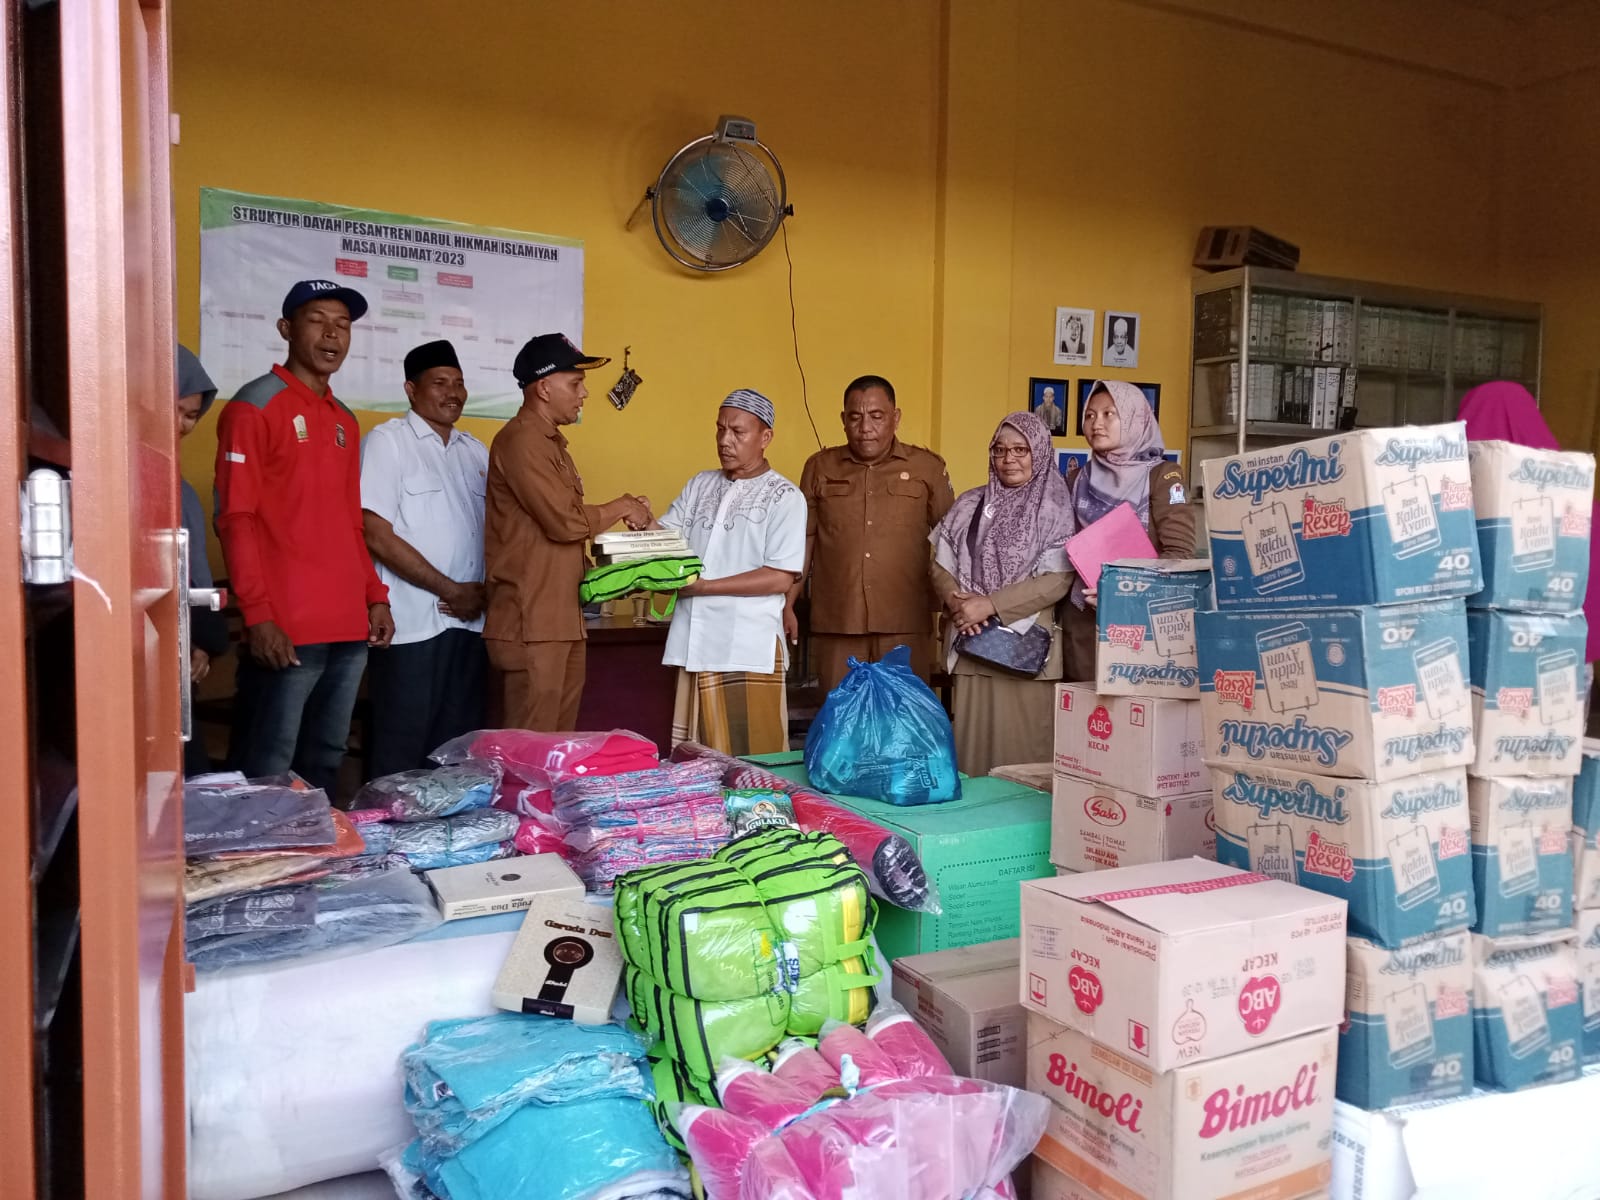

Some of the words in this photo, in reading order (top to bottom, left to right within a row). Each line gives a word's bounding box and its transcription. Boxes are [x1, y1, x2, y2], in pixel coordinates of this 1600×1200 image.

[232, 206, 300, 227] STRUKTUR
[303, 215, 342, 232] DAYAH
[344, 221, 412, 242] PESANTREN
[415, 231, 451, 247] DARUL
[454, 235, 499, 253] HIKMAH
[501, 243, 558, 261] ISLAMIYAH
[342, 238, 377, 254] MASA
[380, 242, 432, 262] KHIDMAT
[435, 251, 465, 266] 2023
[1247, 460, 1257, 468] mi
[1258, 455, 1284, 466] instan
[1303, 512, 1349, 535] Resep
[1254, 535, 1288, 558] Kaldu
[1260, 547, 1292, 570] Ayam
[1439, 554, 1470, 570] 40
[1118, 581, 1151, 592] 40
[1547, 578, 1574, 592] 40
[1107, 626, 1144, 642] Resep
[1159, 621, 1191, 635] Kaldu
[1382, 627, 1416, 643] 40
[1512, 631, 1543, 647] 40
[1265, 647, 1301, 667] Ayam
[1269, 660, 1305, 681] Kaldu
[1215, 674, 1254, 695] Resep
[1089, 719, 1111, 735] ABC
[1087, 741, 1110, 752] KECAP
[1270, 751, 1297, 762] instan
[1156, 773, 1180, 782] CONTENT
[1266, 776, 1292, 788] instan
[1090, 800, 1120, 821] Sasa
[749, 818, 786, 830] GULAKU
[1105, 836, 1126, 847] TOMAT
[1256, 854, 1289, 872] Kaldu
[1305, 846, 1352, 877] Resep
[998, 867, 1025, 877] DAFTAR
[1439, 898, 1466, 916] 40
[1534, 895, 1561, 909] 40
[544, 919, 585, 934] Garuda
[1110, 927, 1125, 938] ABC
[1070, 948, 1101, 969] KECAP
[1241, 952, 1279, 973] KECAP
[1070, 973, 1100, 999] ABC
[1240, 985, 1278, 1015] ABC
[1176, 1044, 1201, 1060] NEW
[1548, 1046, 1574, 1064] 40
[1432, 1059, 1461, 1077] 40
[1046, 1052, 1143, 1134] Bimoli
[1198, 1061, 1319, 1139] Bimoli
